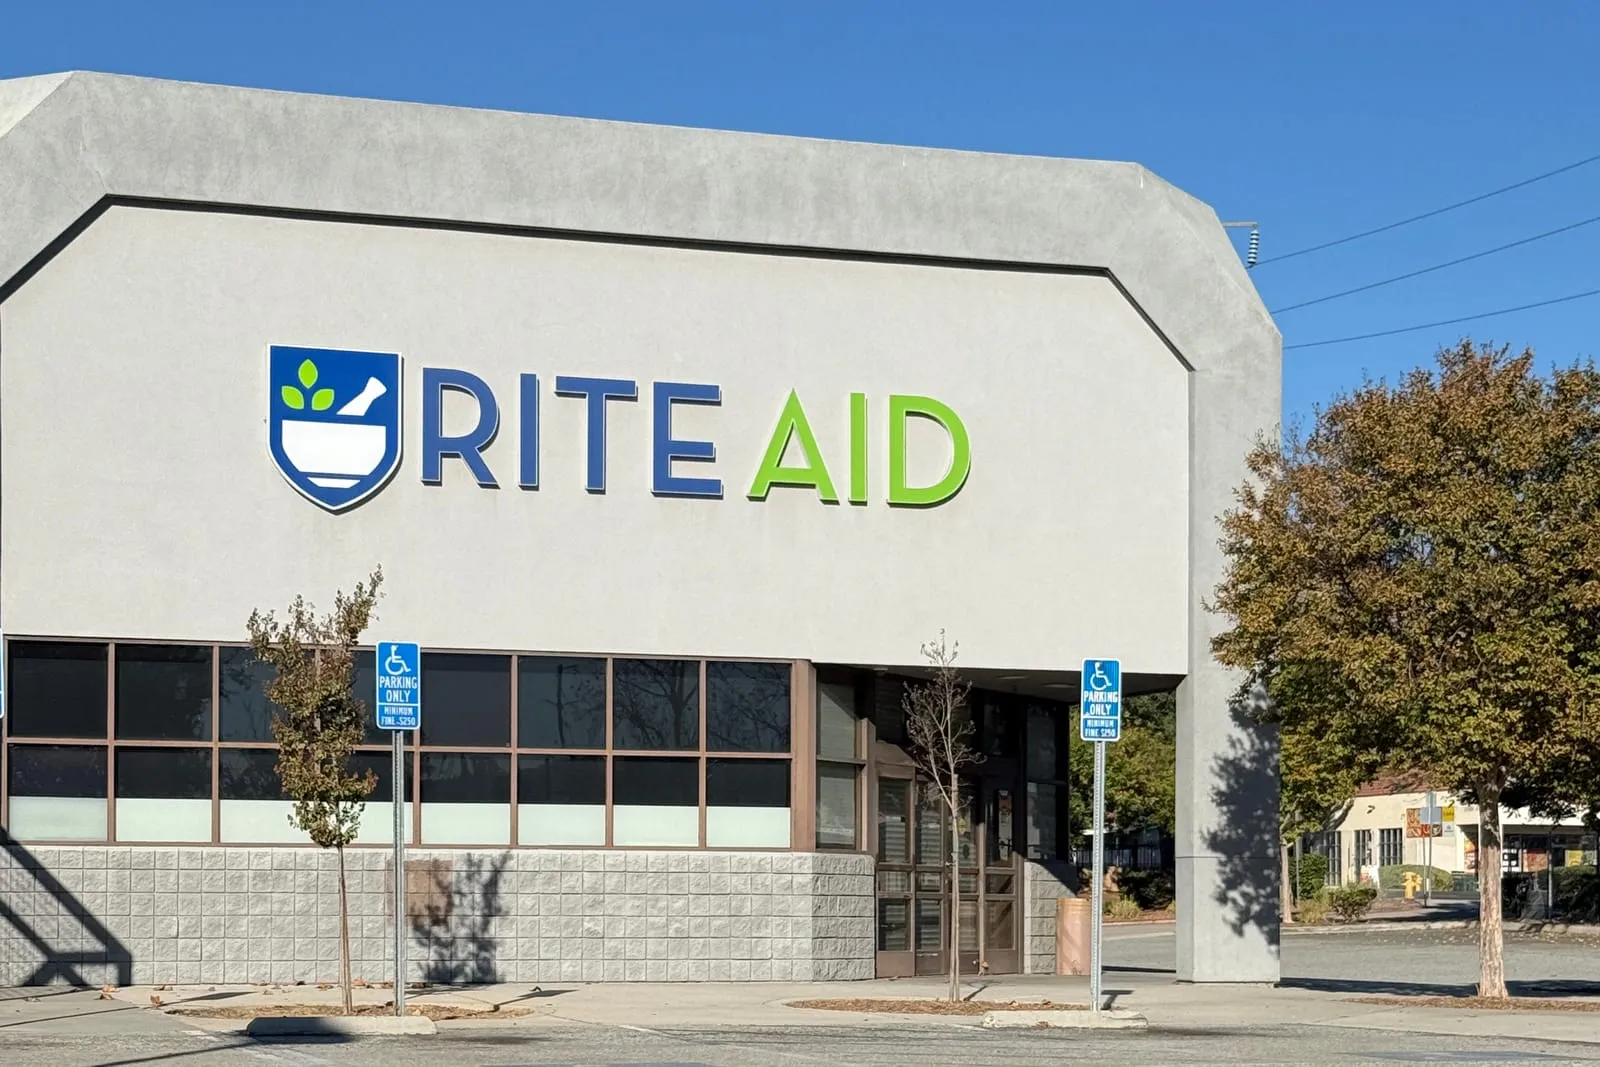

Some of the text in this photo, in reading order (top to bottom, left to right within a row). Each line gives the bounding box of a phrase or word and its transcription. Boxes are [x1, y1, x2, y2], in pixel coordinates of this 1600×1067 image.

[421, 367, 971, 506] RITE AID
[379, 676, 418, 689] PARKING
[386, 690, 411, 702] ONLY
[1084, 691, 1118, 703] PARKING
[384, 706, 413, 715] MINIMUM
[1089, 704, 1112, 715] ONLY
[381, 716, 416, 726] FINE $250
[1087, 719, 1114, 727] MINIMUM
[1085, 728, 1098, 737] FINE
